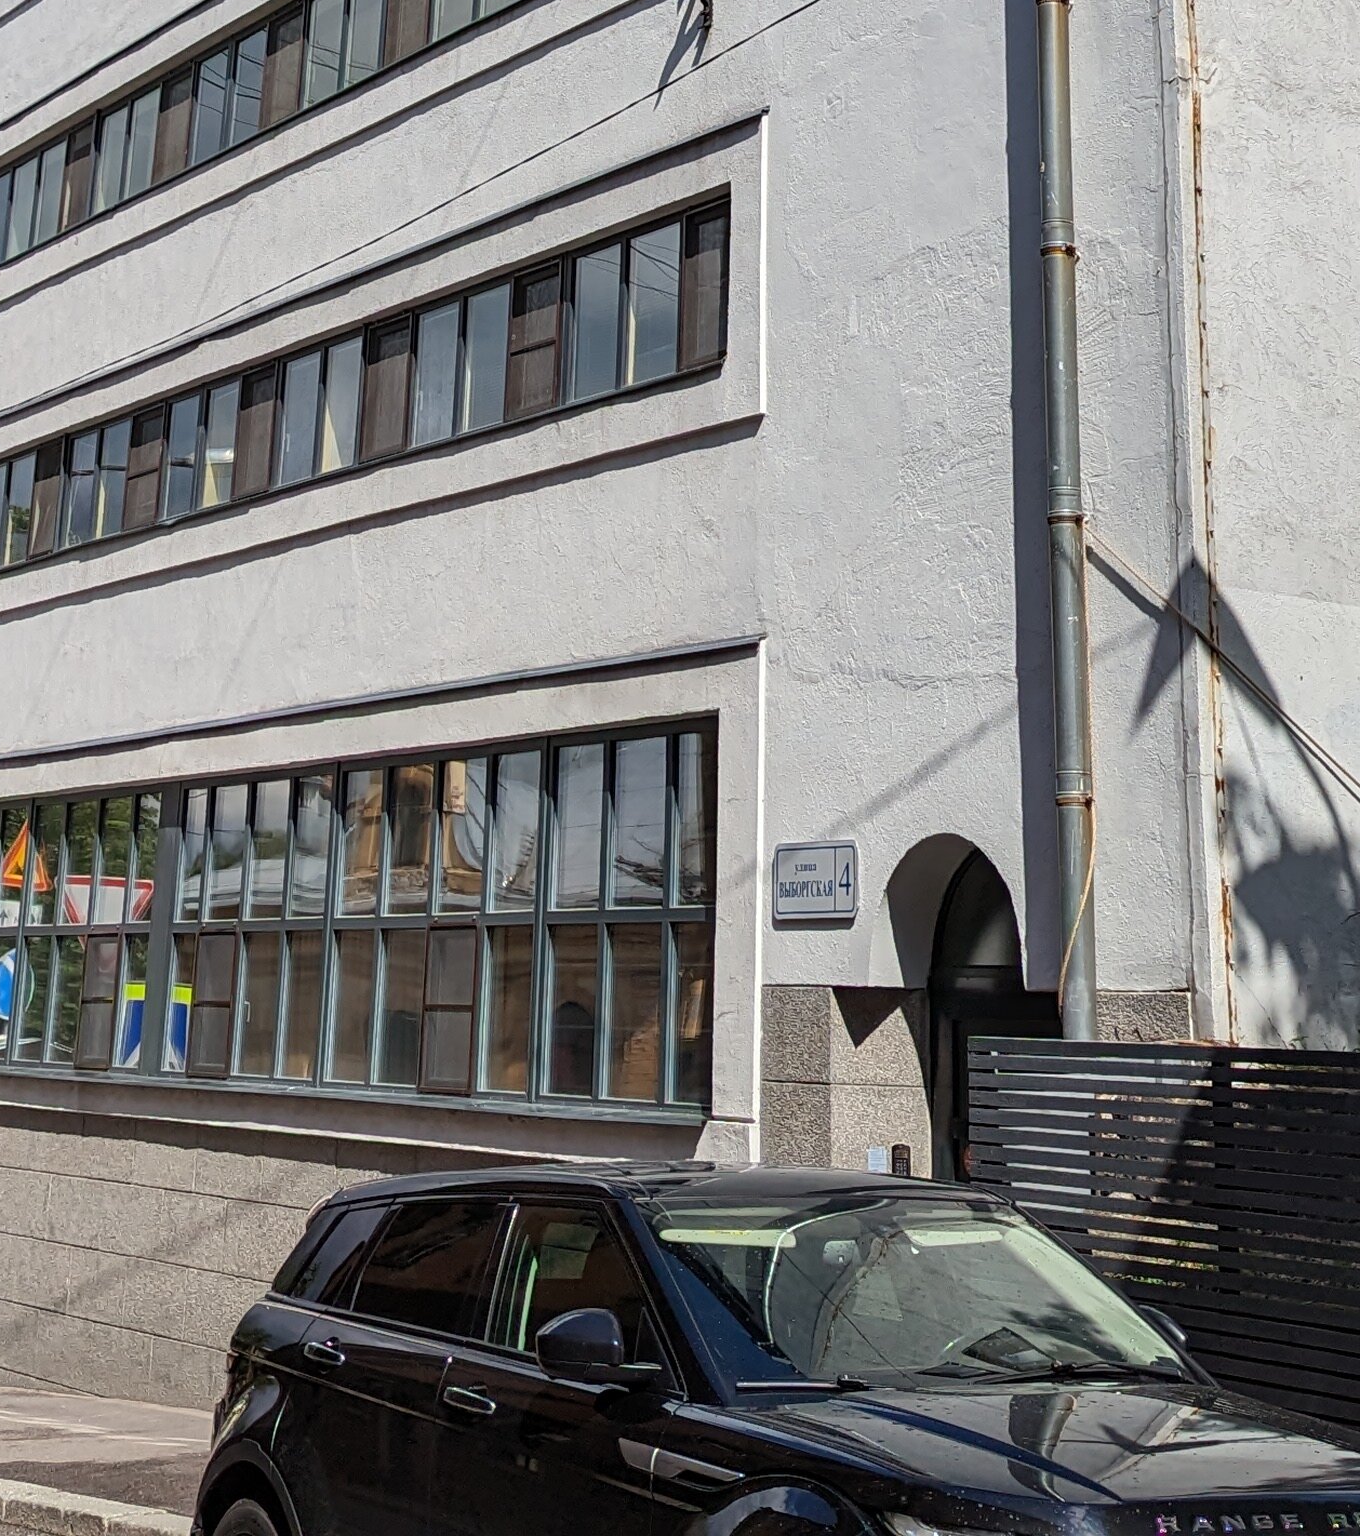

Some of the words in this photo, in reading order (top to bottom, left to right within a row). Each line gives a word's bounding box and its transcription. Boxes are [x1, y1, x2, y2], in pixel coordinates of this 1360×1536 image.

[839, 862, 851, 896] 4
[779, 880, 833, 898] ВЫБОРГСКАЯ
[1156, 1514, 1304, 1533] RANGE
